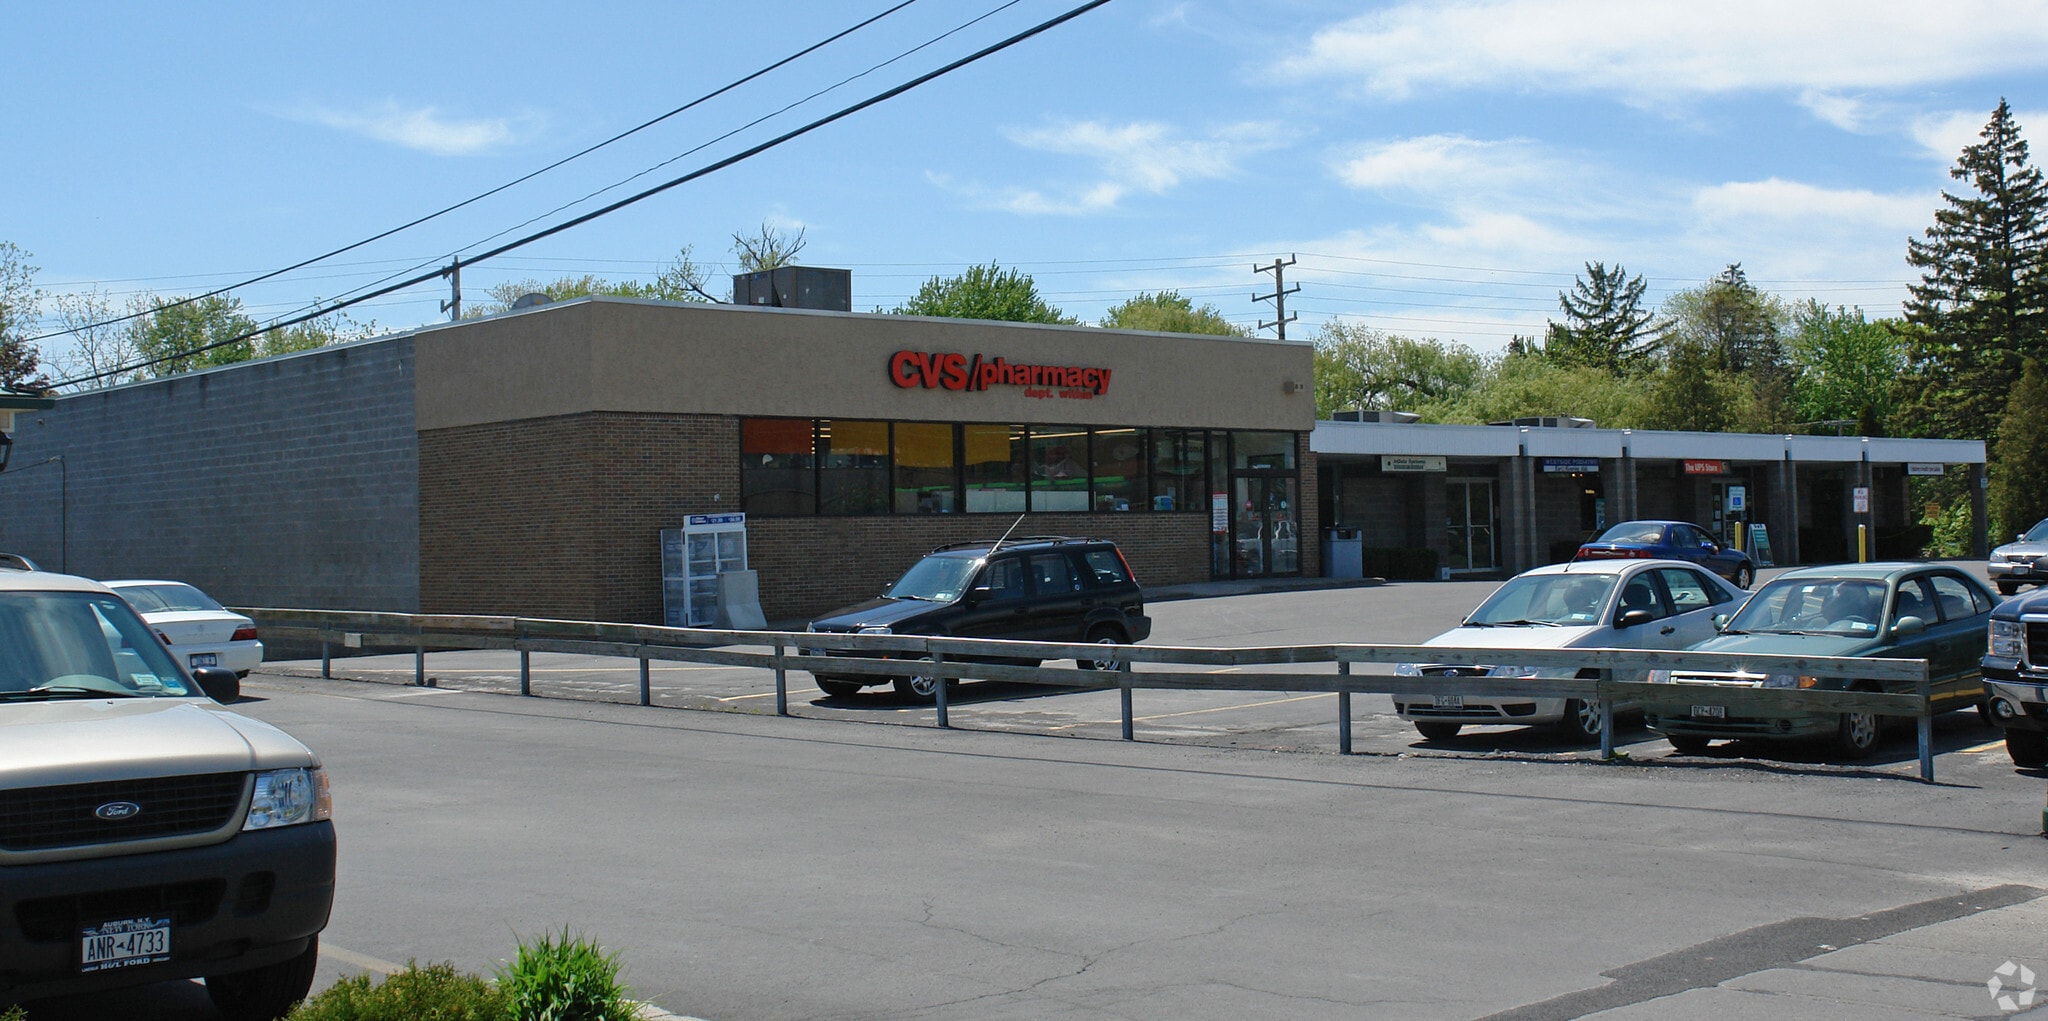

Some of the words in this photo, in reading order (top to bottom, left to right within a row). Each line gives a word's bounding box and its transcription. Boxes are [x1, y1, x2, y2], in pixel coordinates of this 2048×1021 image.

[889, 350, 1112, 395] CVS/pharmacy
[1024, 387, 1053, 399] dept.
[1059, 389, 1093, 399] within
[1685, 463, 1694, 471] The
[1695, 463, 1704, 471] UPS
[1705, 463, 1717, 472] Store
[106, 805, 130, 816] Ford
[102, 925, 123, 934] NEW
[126, 921, 150, 932] YORK
[123, 957, 151, 967] FORD
